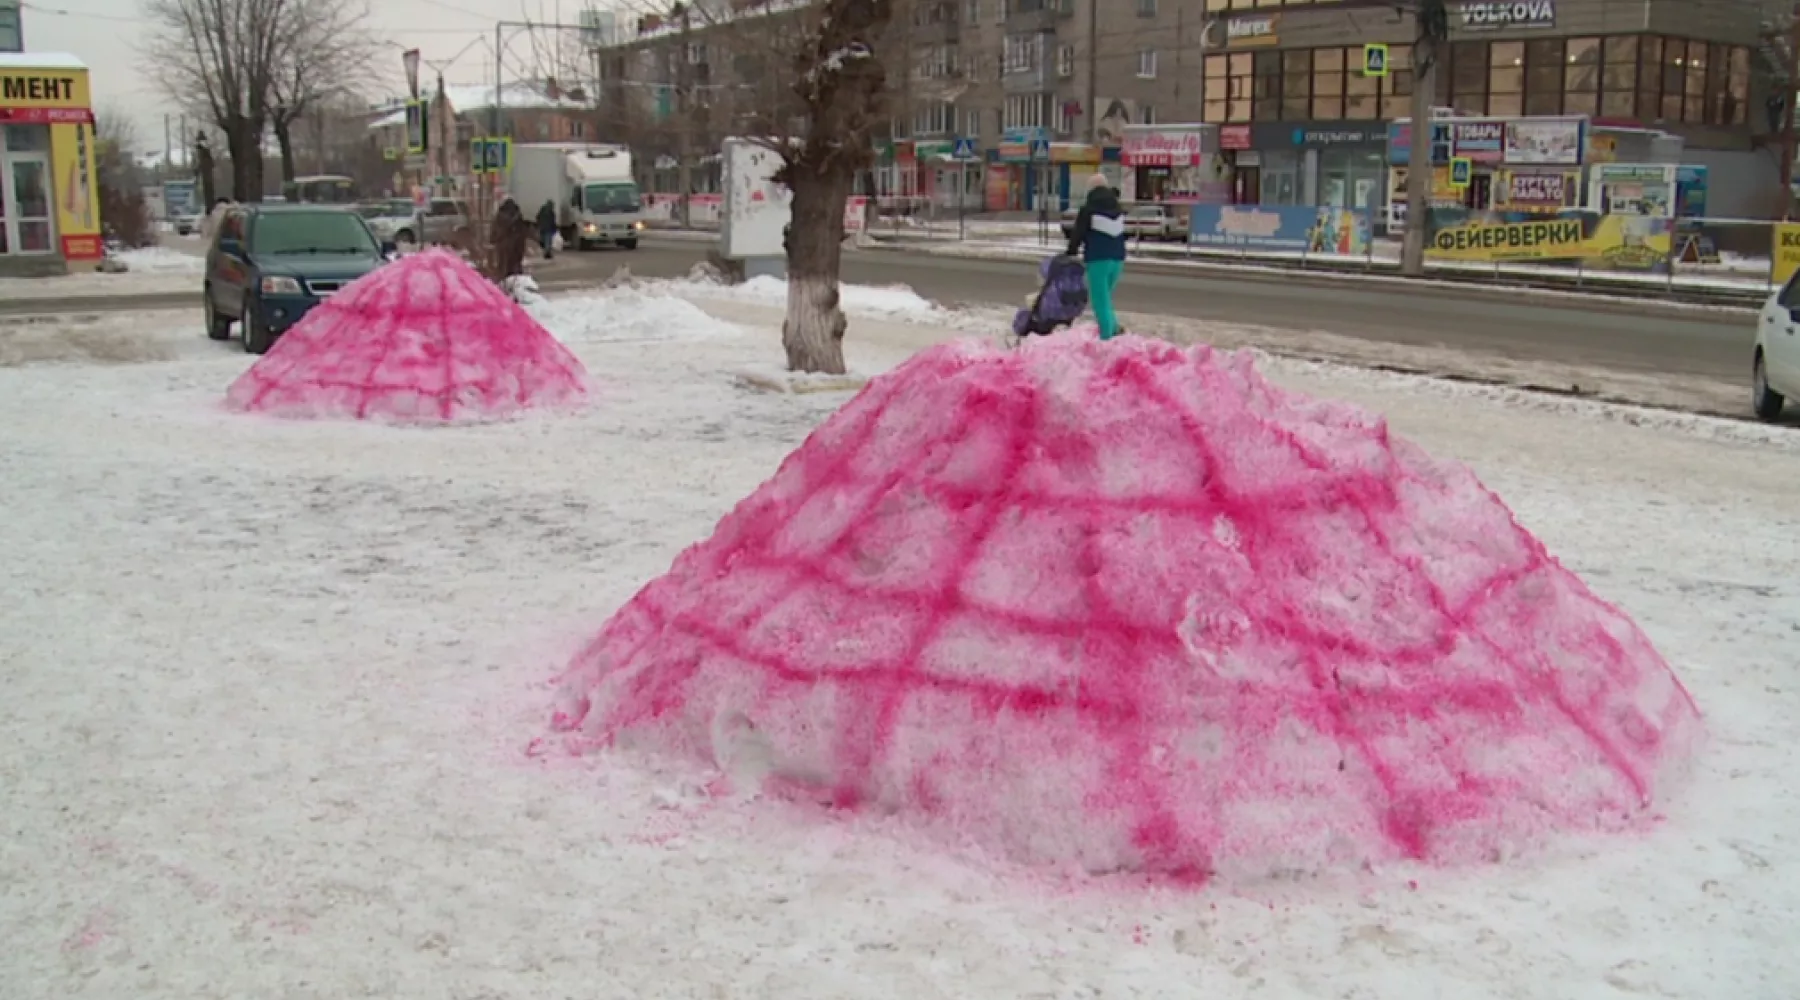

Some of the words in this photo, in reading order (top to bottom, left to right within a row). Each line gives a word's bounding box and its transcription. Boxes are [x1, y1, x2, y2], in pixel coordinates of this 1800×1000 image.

[1460, 0, 1553, 22] VOLKOVA
[0, 75, 75, 99] МЕНТ
[1458, 124, 1501, 140] ТОВАРЫ
[1511, 187, 1564, 200] ПАЛЬТО
[1437, 222, 1580, 250] ФЕЙЕРВЕРКИ
